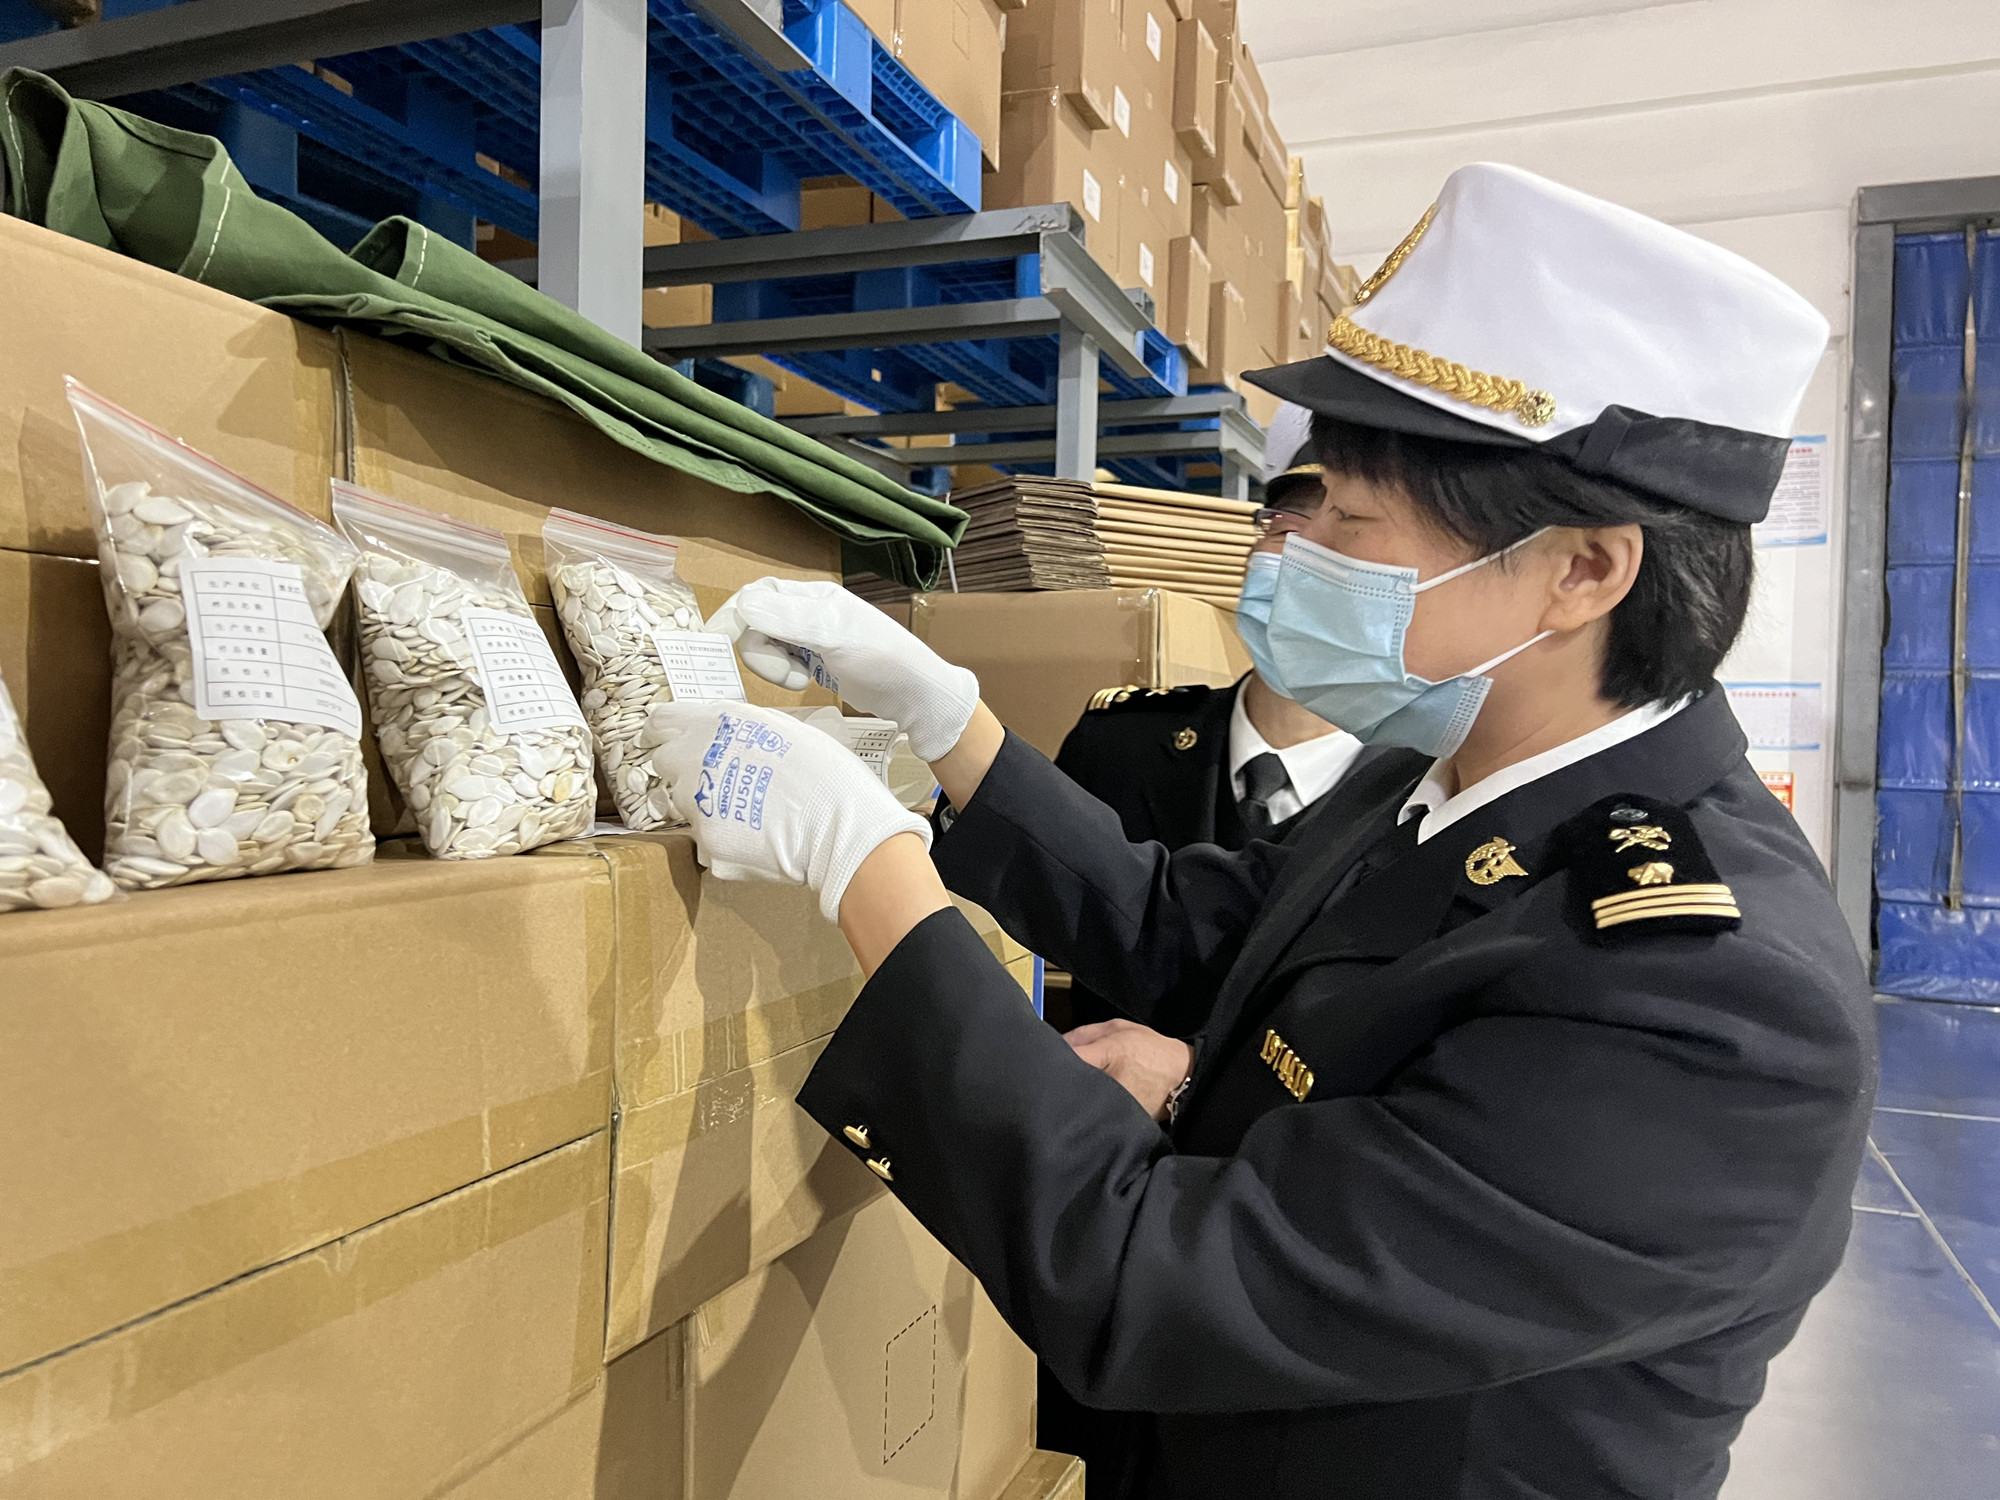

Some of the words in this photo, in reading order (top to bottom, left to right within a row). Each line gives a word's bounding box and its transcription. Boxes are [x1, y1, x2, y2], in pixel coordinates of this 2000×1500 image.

[715, 717, 742, 769] XINGYU
[720, 761, 739, 814] SINOPPE
[735, 763, 758, 823] PU508
[751, 799, 762, 824] SIZE
